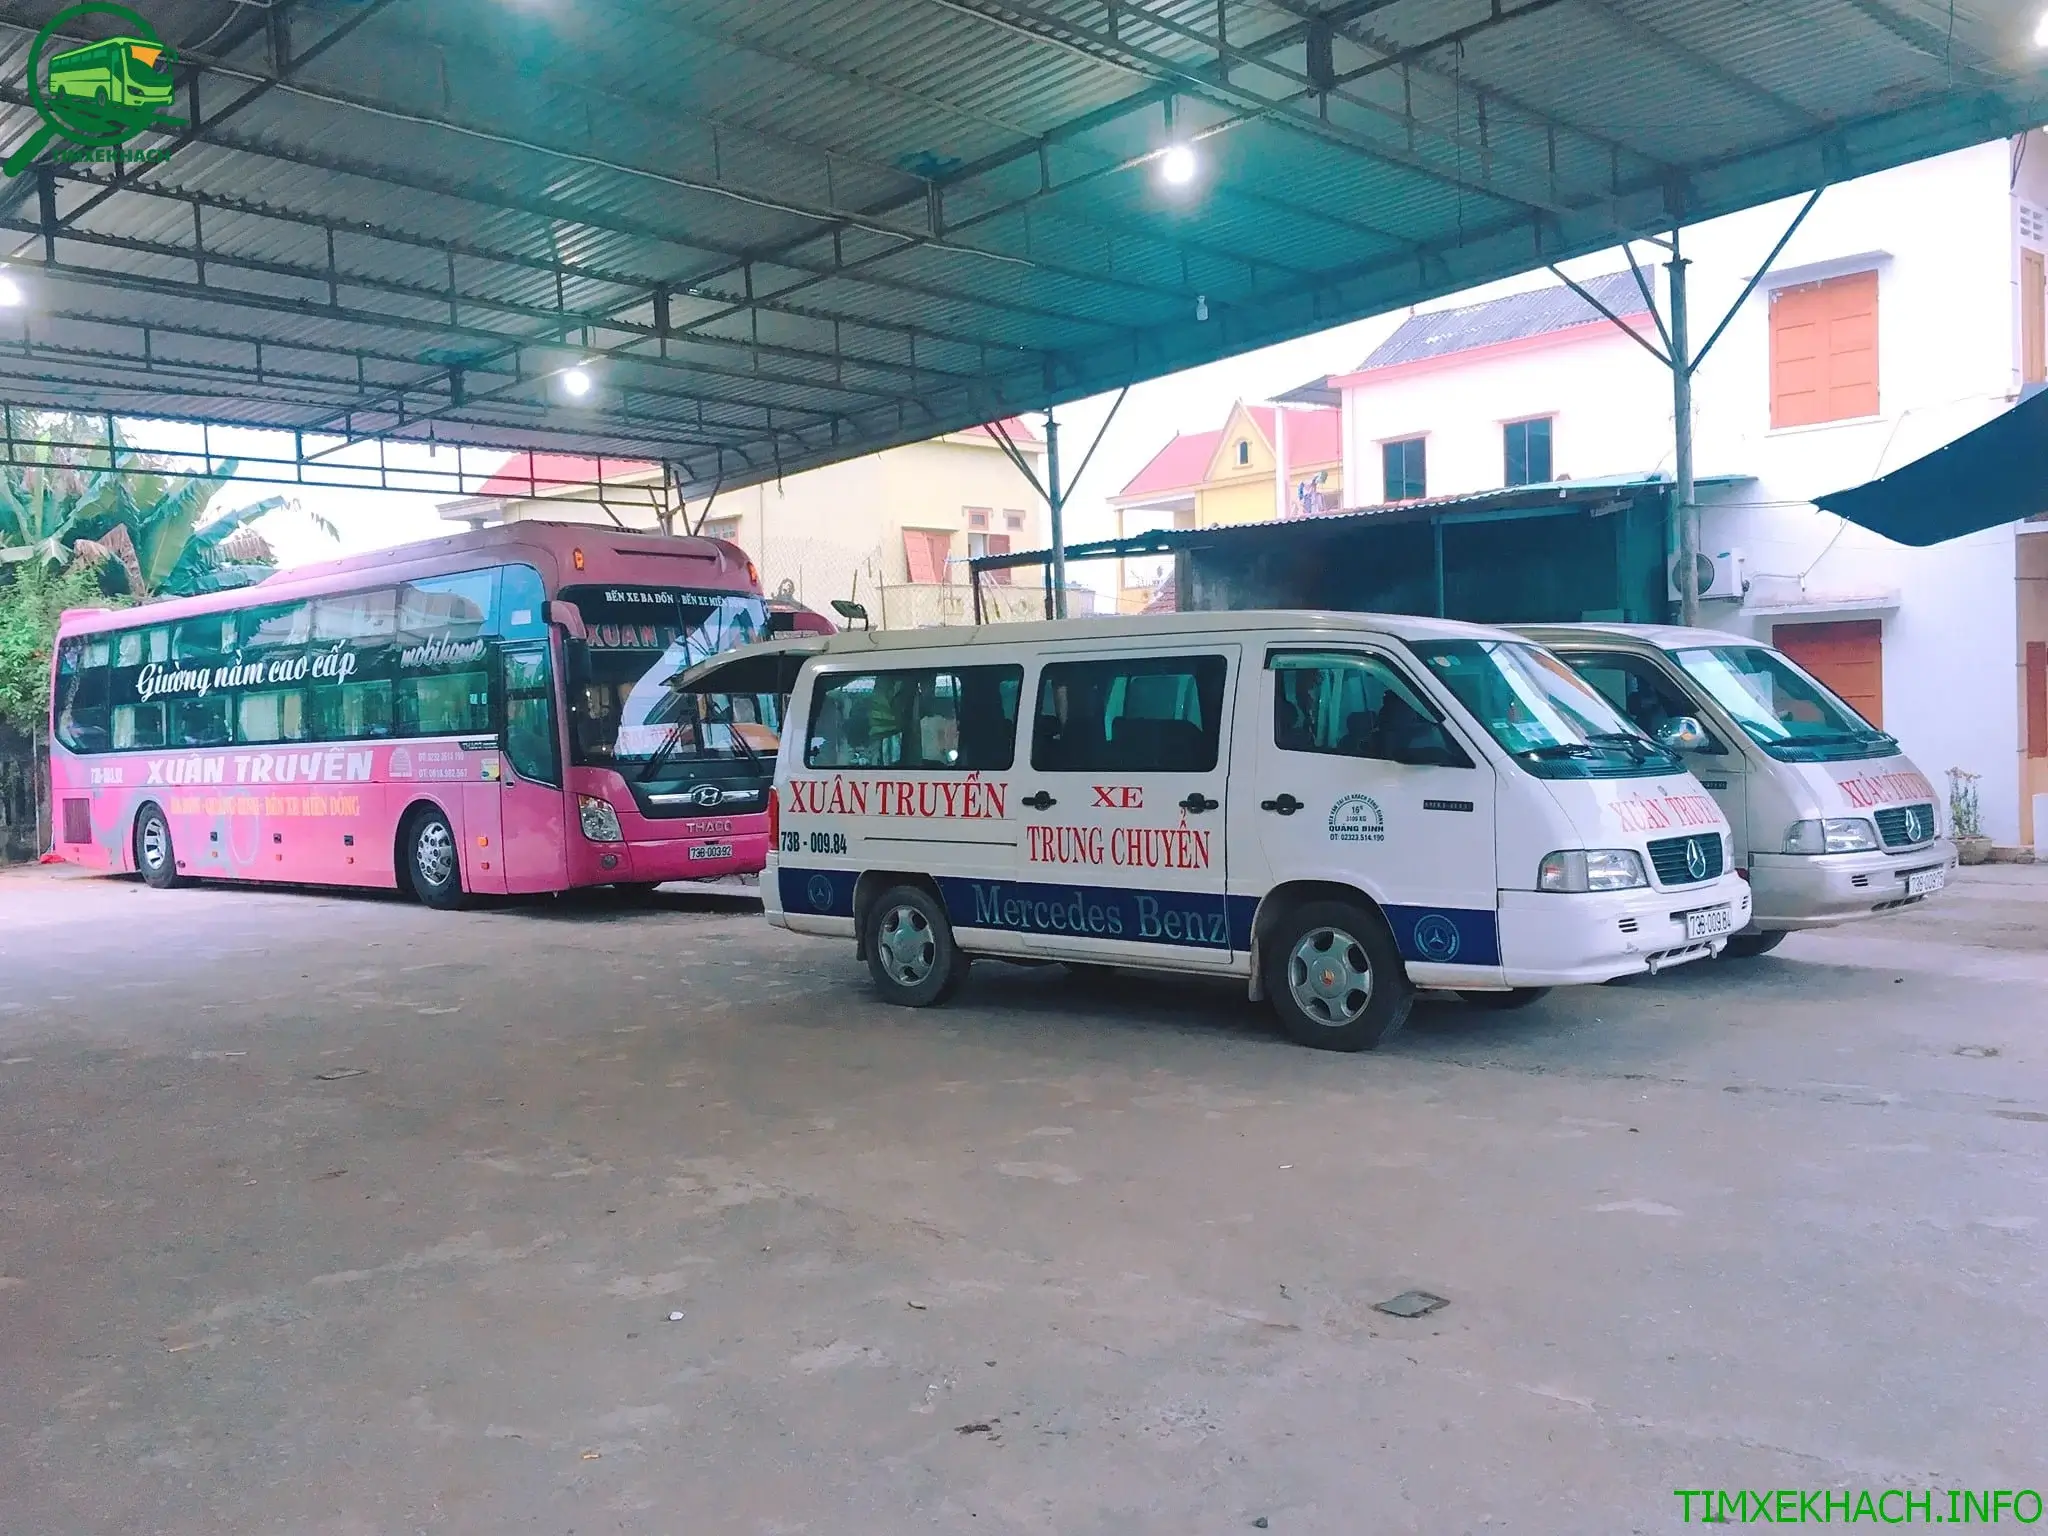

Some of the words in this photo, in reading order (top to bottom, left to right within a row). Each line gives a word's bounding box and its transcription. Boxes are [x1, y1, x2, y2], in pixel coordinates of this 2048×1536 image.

[626, 592, 640, 602] XE
[640, 592, 654, 603] BA
[698, 596, 709, 605] XE
[400, 631, 487, 668] mobihome
[136, 661, 212, 703] Giường
[268, 656, 310, 683] cao
[312, 639, 358, 685] cấp
[146, 752, 225, 784] XUÂN
[789, 774, 869, 815] XUÂN
[1090, 785, 1143, 809] XE
[686, 820, 732, 833] THACO
[781, 831, 800, 852] 73B
[810, 832, 847, 854] 009.84
[1026, 825, 1104, 865] TRUNG
[1110, 807, 1210, 869] CHUYỂN
[972, 884, 1123, 935] Mercedes
[1134, 895, 1227, 944] Benz
